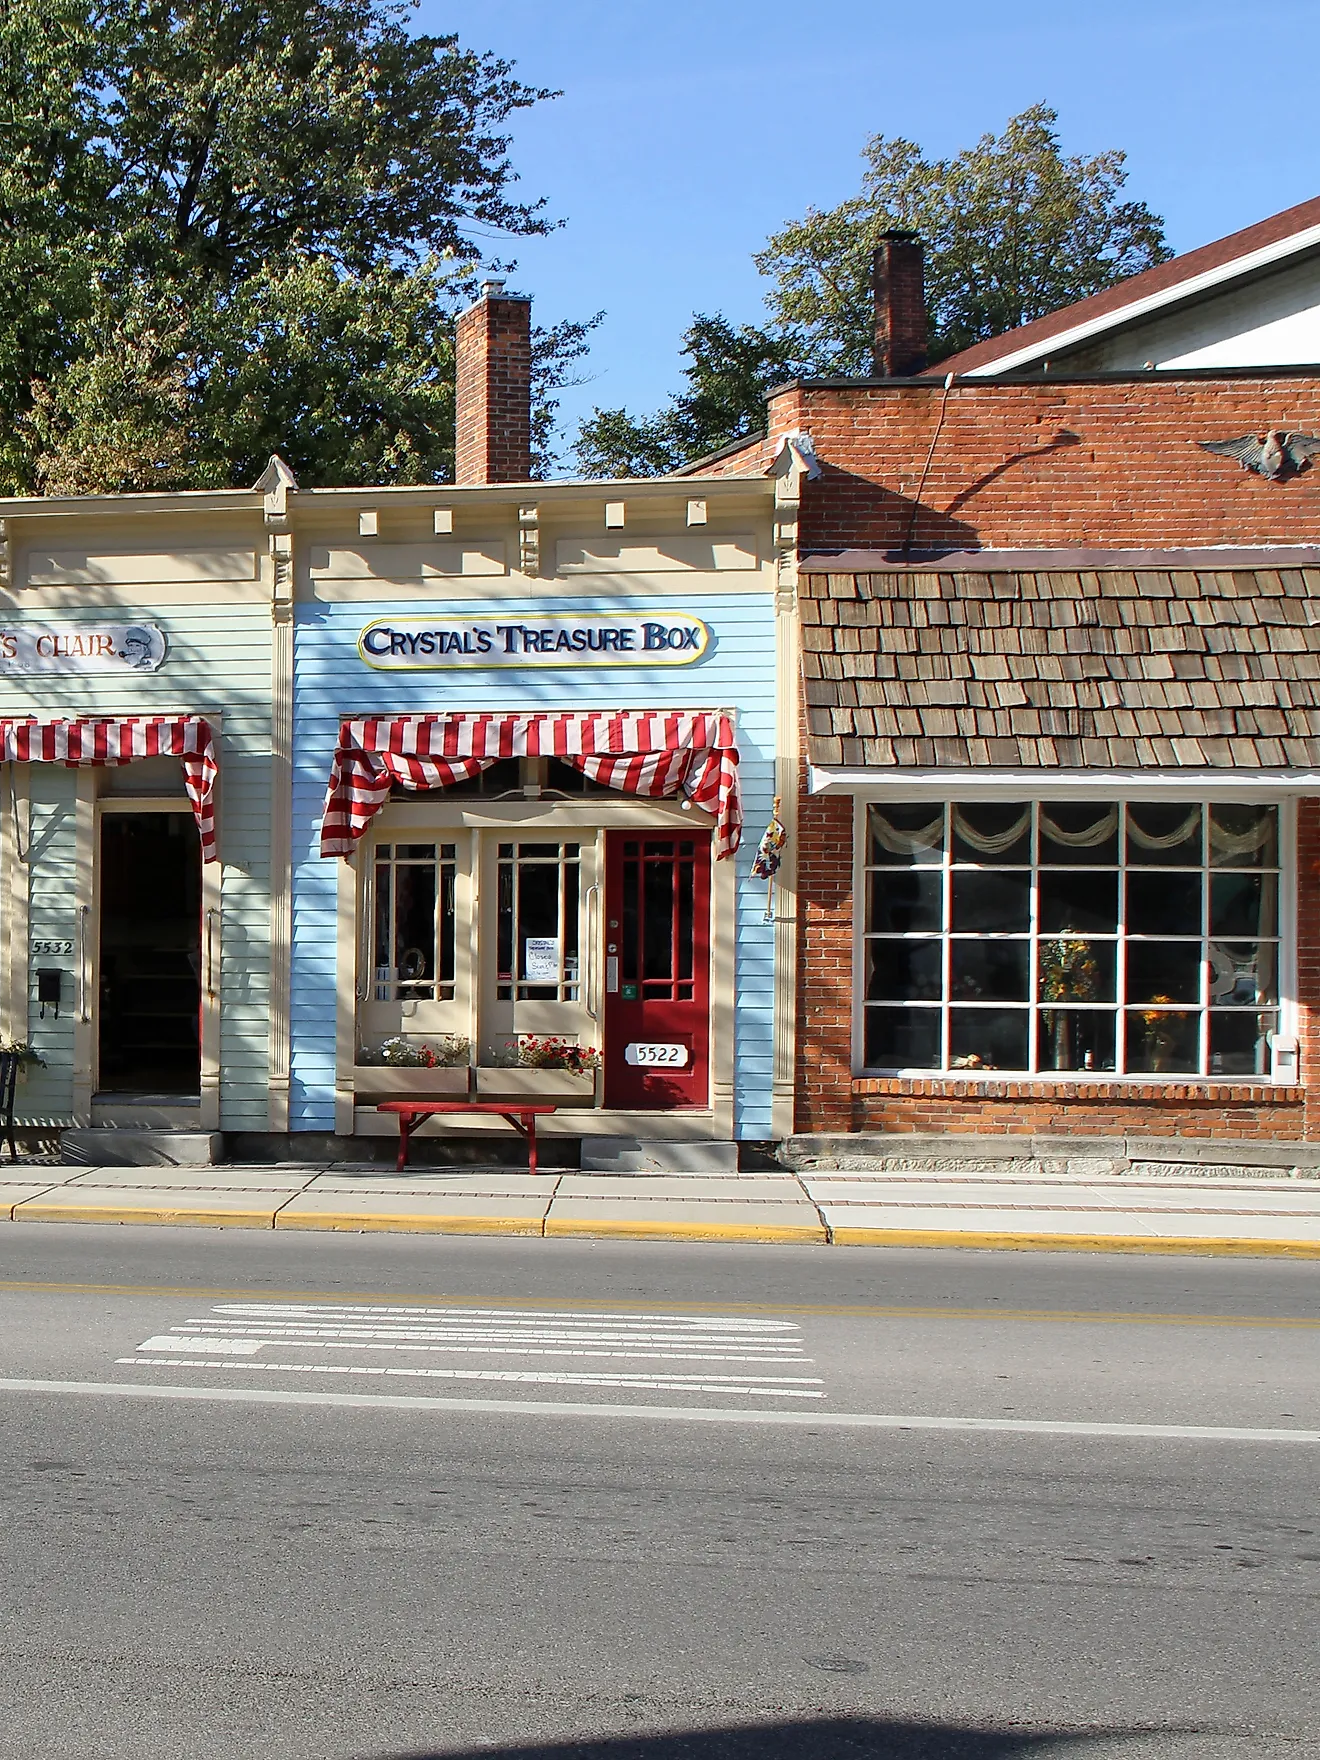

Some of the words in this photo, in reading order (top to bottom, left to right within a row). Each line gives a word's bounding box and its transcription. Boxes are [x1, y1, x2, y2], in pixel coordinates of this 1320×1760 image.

[36, 634, 117, 658] CHAIR
[363, 627, 492, 655] CRYSTAL'S
[497, 625, 636, 654] TREASURE
[640, 623, 699, 650] BOX
[32, 942, 72, 954] 5532
[638, 1047, 679, 1062] 5522
[114, 1304, 828, 1398] ONLY
